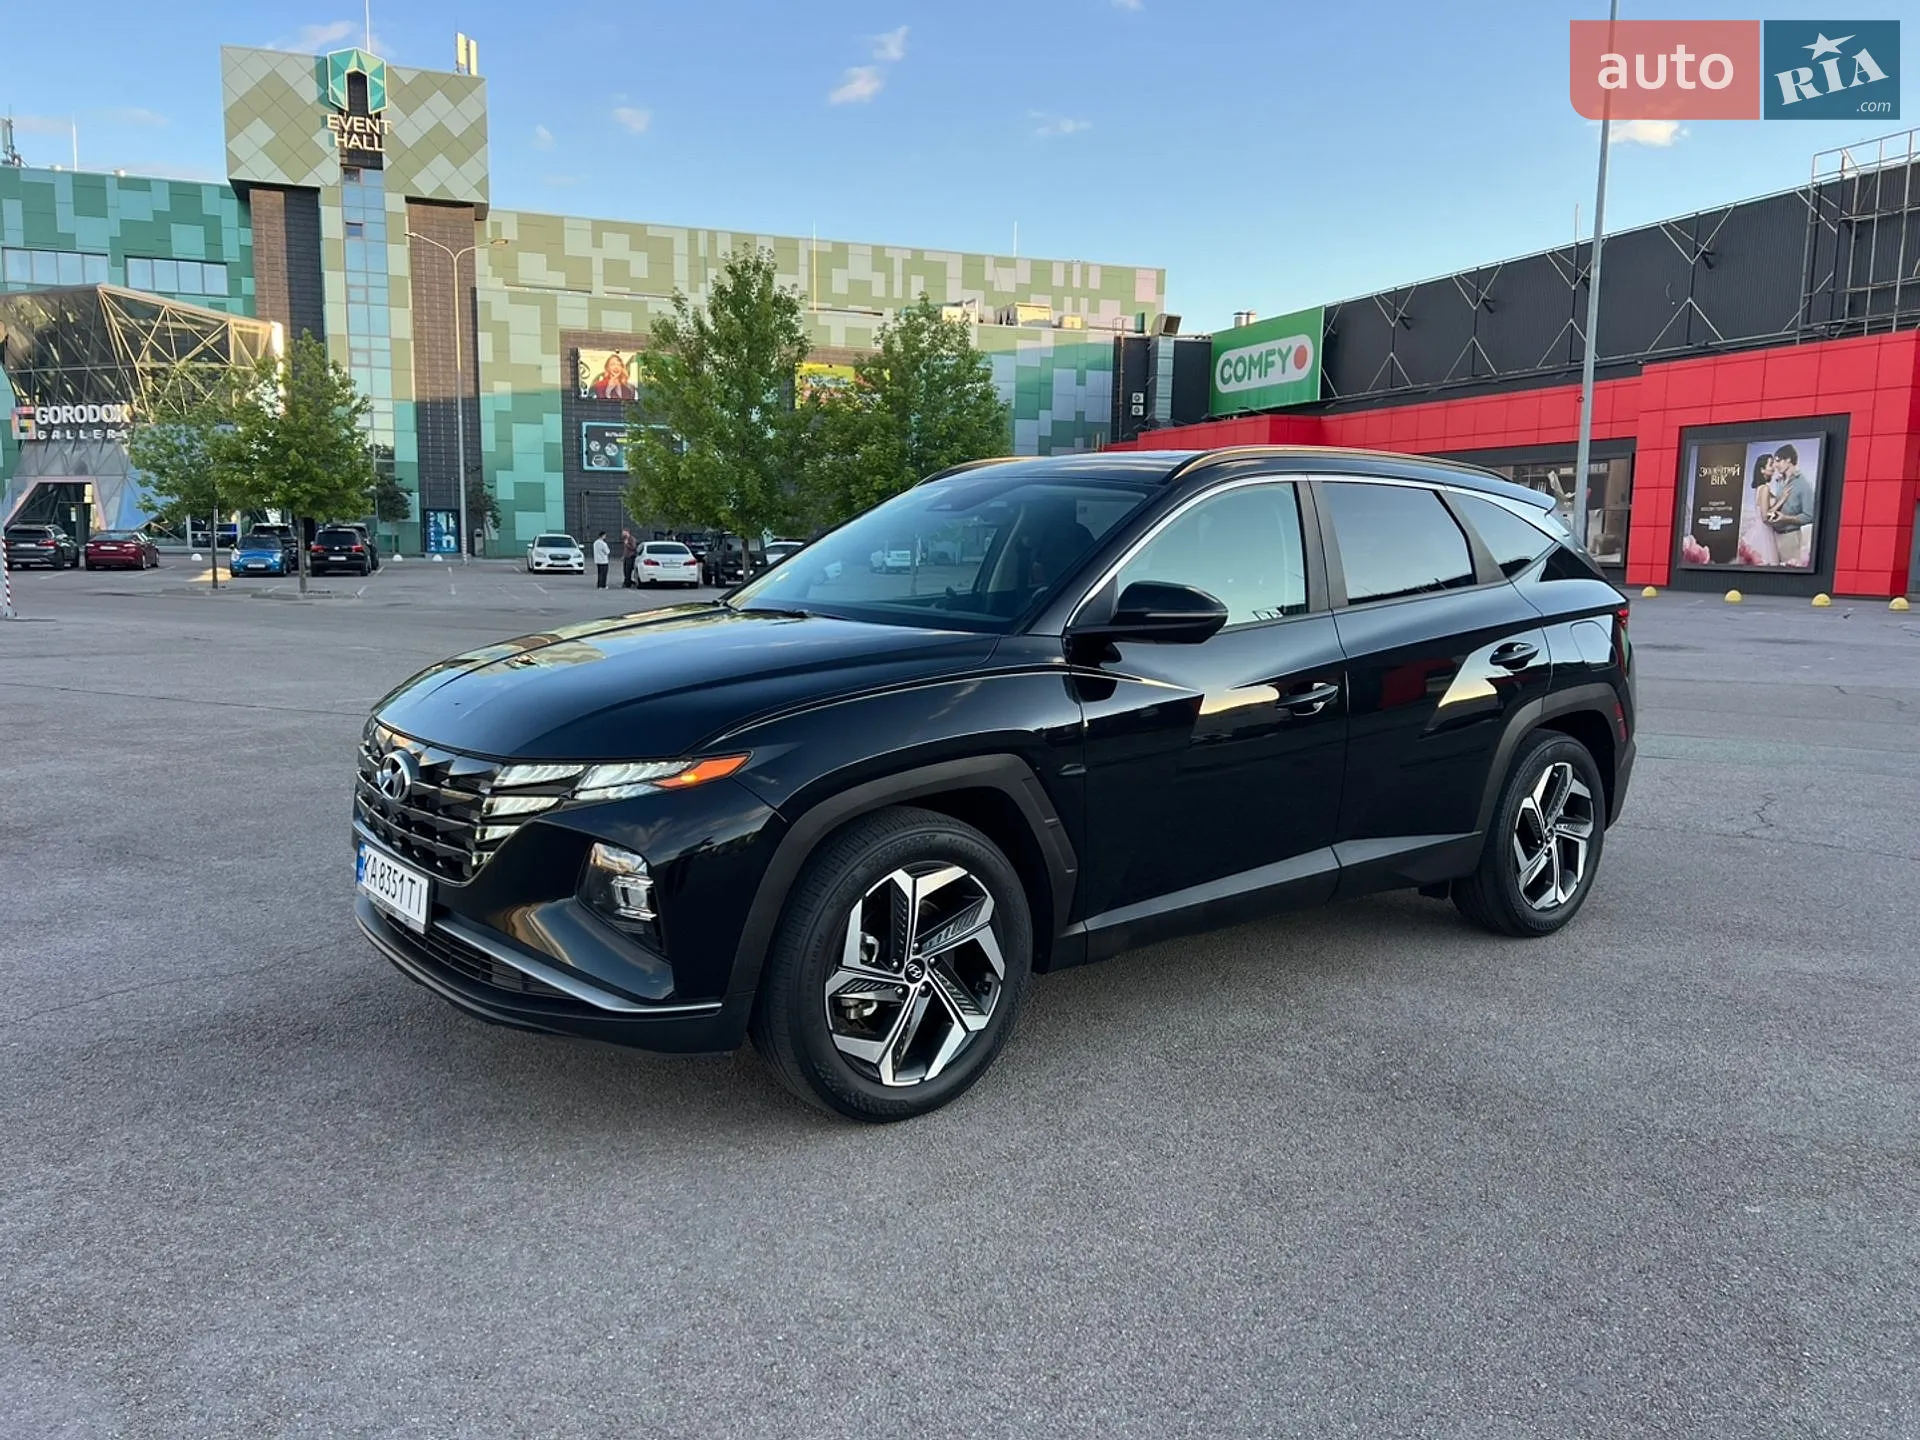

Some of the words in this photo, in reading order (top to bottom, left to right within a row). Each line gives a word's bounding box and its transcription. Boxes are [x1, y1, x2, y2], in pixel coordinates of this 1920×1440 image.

[326, 113, 392, 135] EVENT
[333, 131, 386, 152] HALL
[1220, 345, 1293, 385] COMFY
[35, 403, 132, 425] GORODOK
